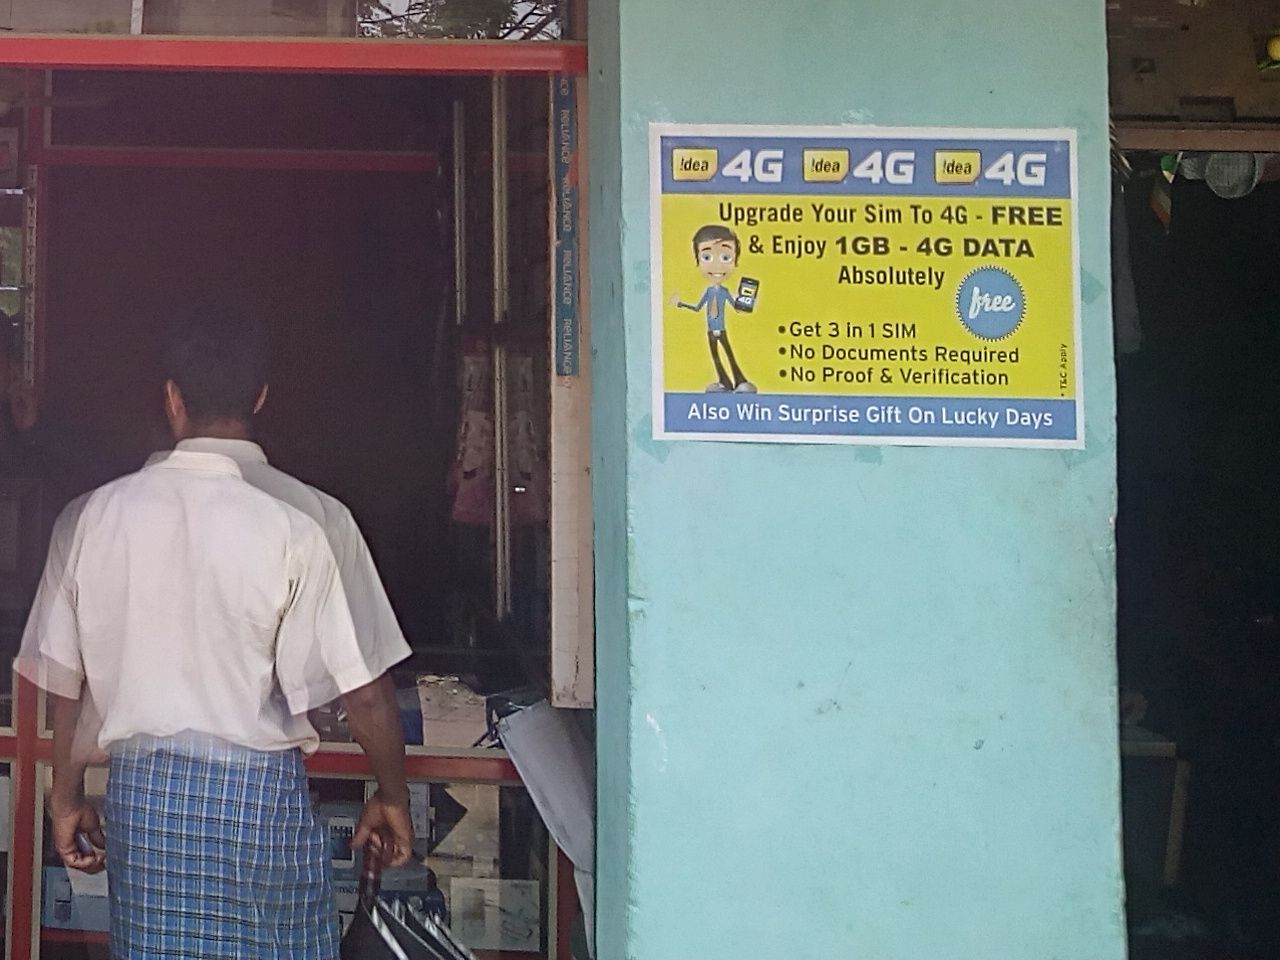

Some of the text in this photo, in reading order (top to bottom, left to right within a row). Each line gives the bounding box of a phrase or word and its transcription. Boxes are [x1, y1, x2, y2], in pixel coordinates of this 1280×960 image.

[722, 149, 784, 182] 4G
[853, 150, 915, 184] 4G
[984, 151, 1047, 186] 4G
[720, 202, 803, 226] Upgrade
[812, 204, 856, 223] Your
[865, 204, 902, 224] Sim
[910, 205, 932, 224] To
[940, 206, 967, 224] 4G
[991, 206, 1063, 226] FREE
[748, 235, 764, 254] &
[772, 236, 827, 258] Enjoy
[835, 237, 890, 256] 1GB
[916, 238, 953, 256] 4G
[963, 238, 1035, 258] DATA
[838, 265, 945, 289] Absolutely
[969, 287, 1016, 319] free
[790, 322, 917, 339] Get 3 in 1 SIM
[790, 344, 1019, 365] No Documents Required
[790, 367, 1009, 386] No Proof & Verification
[688, 403, 1053, 428] Also Win Surprise Gift On Lucky Days
